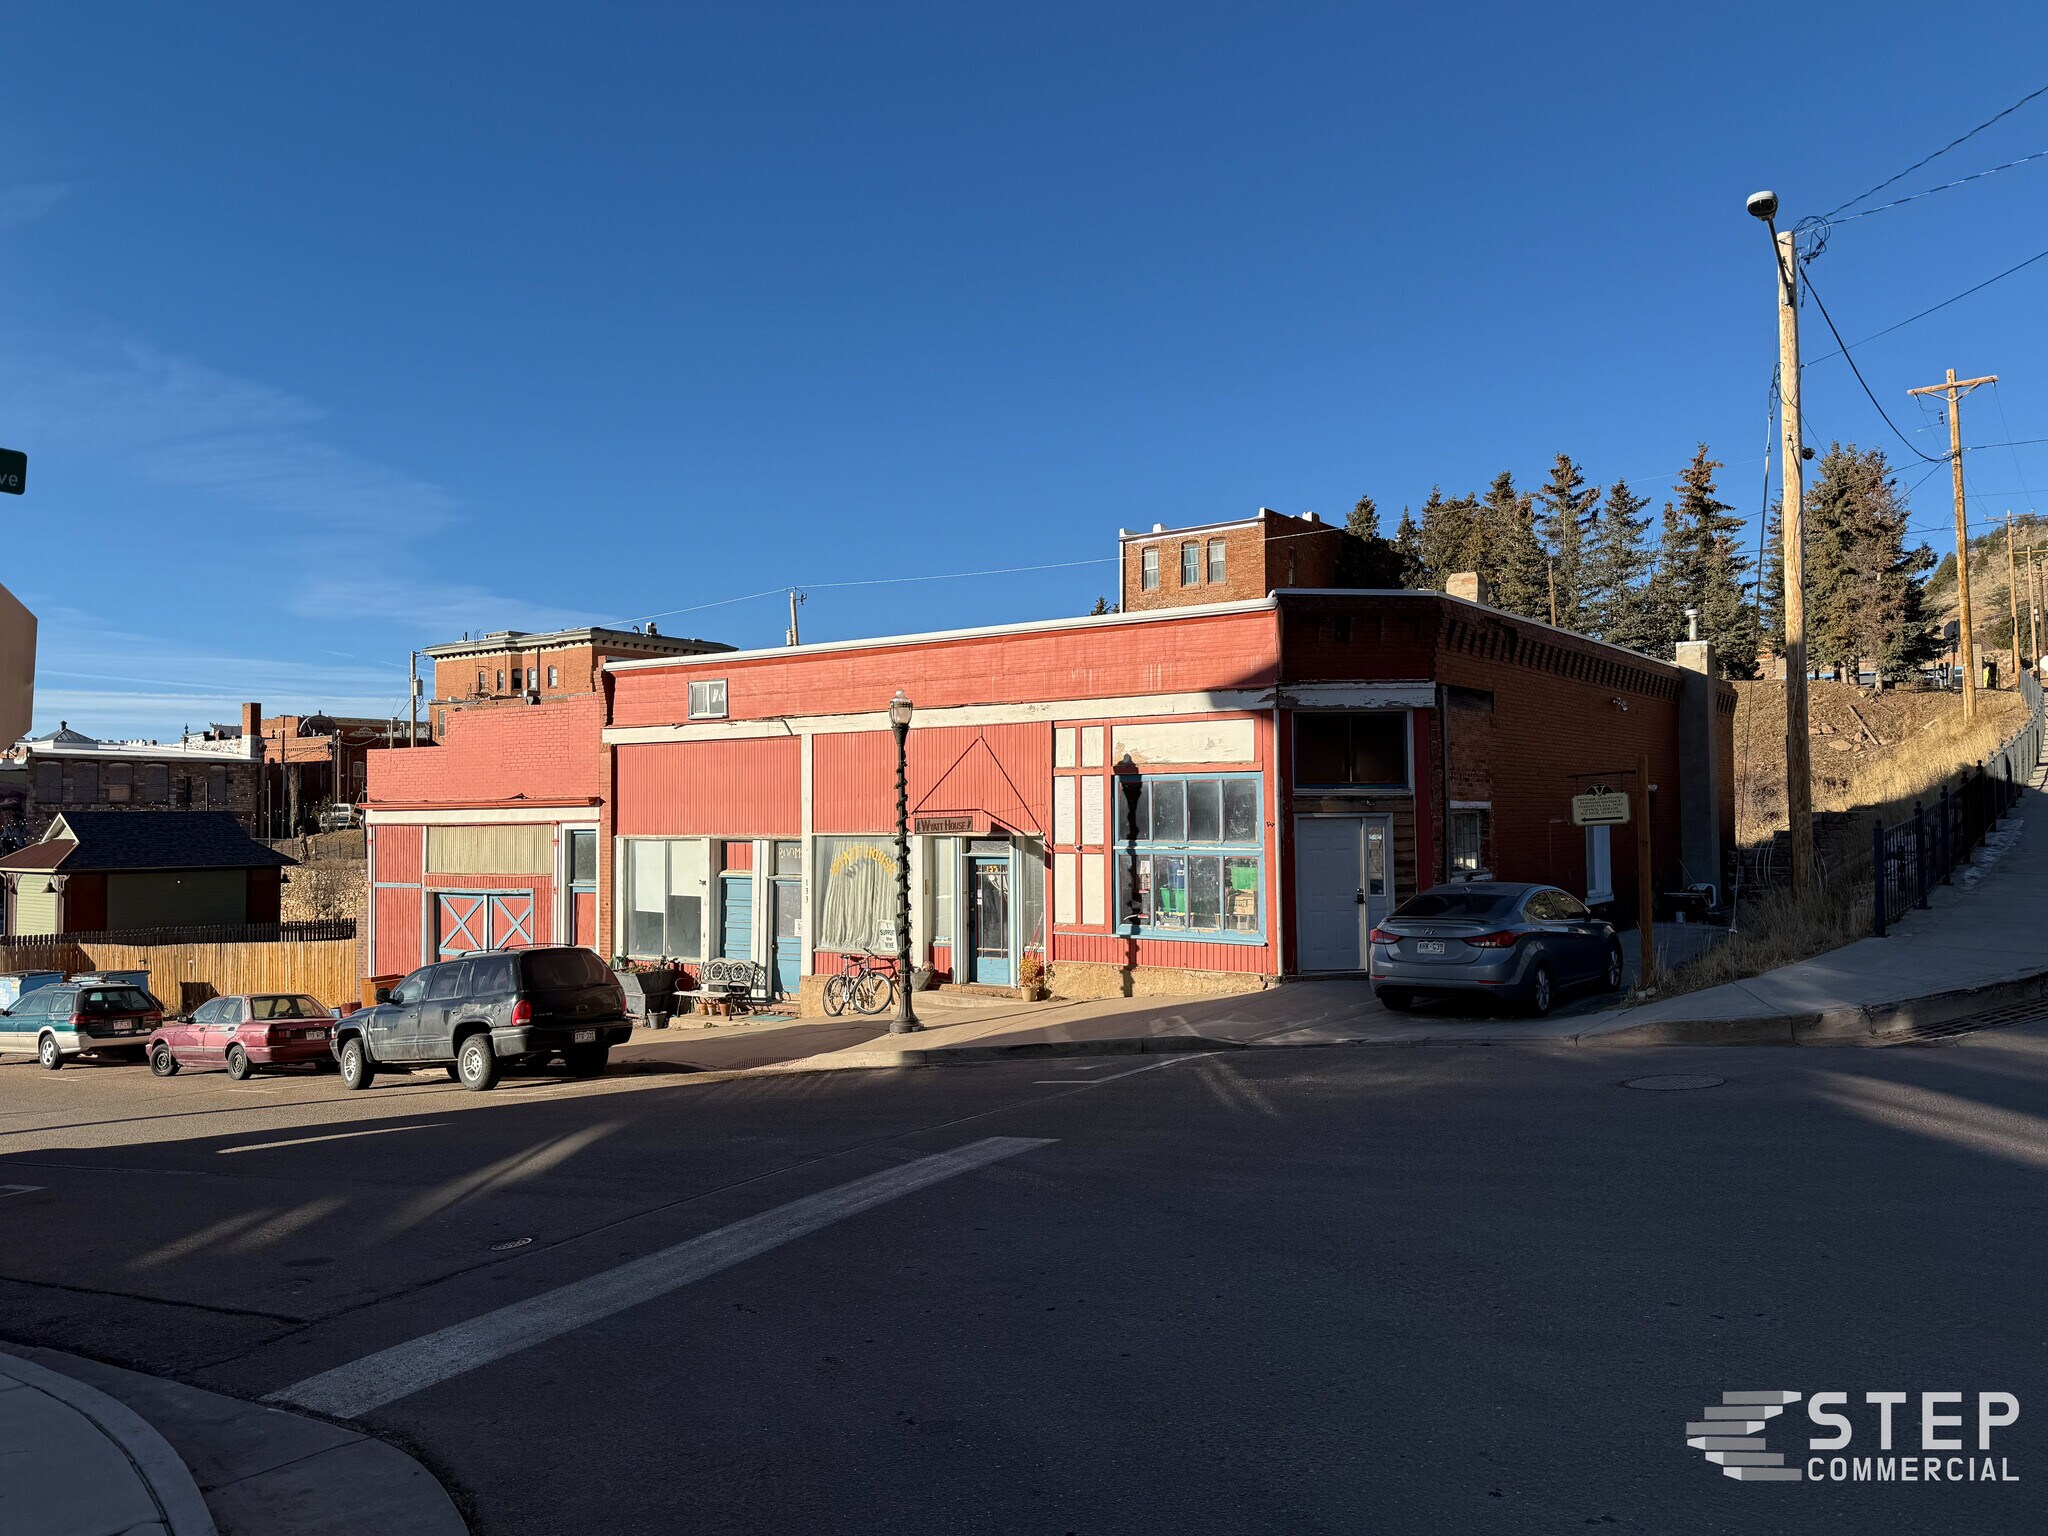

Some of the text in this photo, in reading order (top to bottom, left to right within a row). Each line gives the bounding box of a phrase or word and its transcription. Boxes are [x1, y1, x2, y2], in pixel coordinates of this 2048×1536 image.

[1592, 785, 1606, 796] V
[921, 819, 966, 831] WYATT HOUSE
[778, 847, 802, 858] ROOM
[830, 845, 897, 876] WYATT HOUSE
